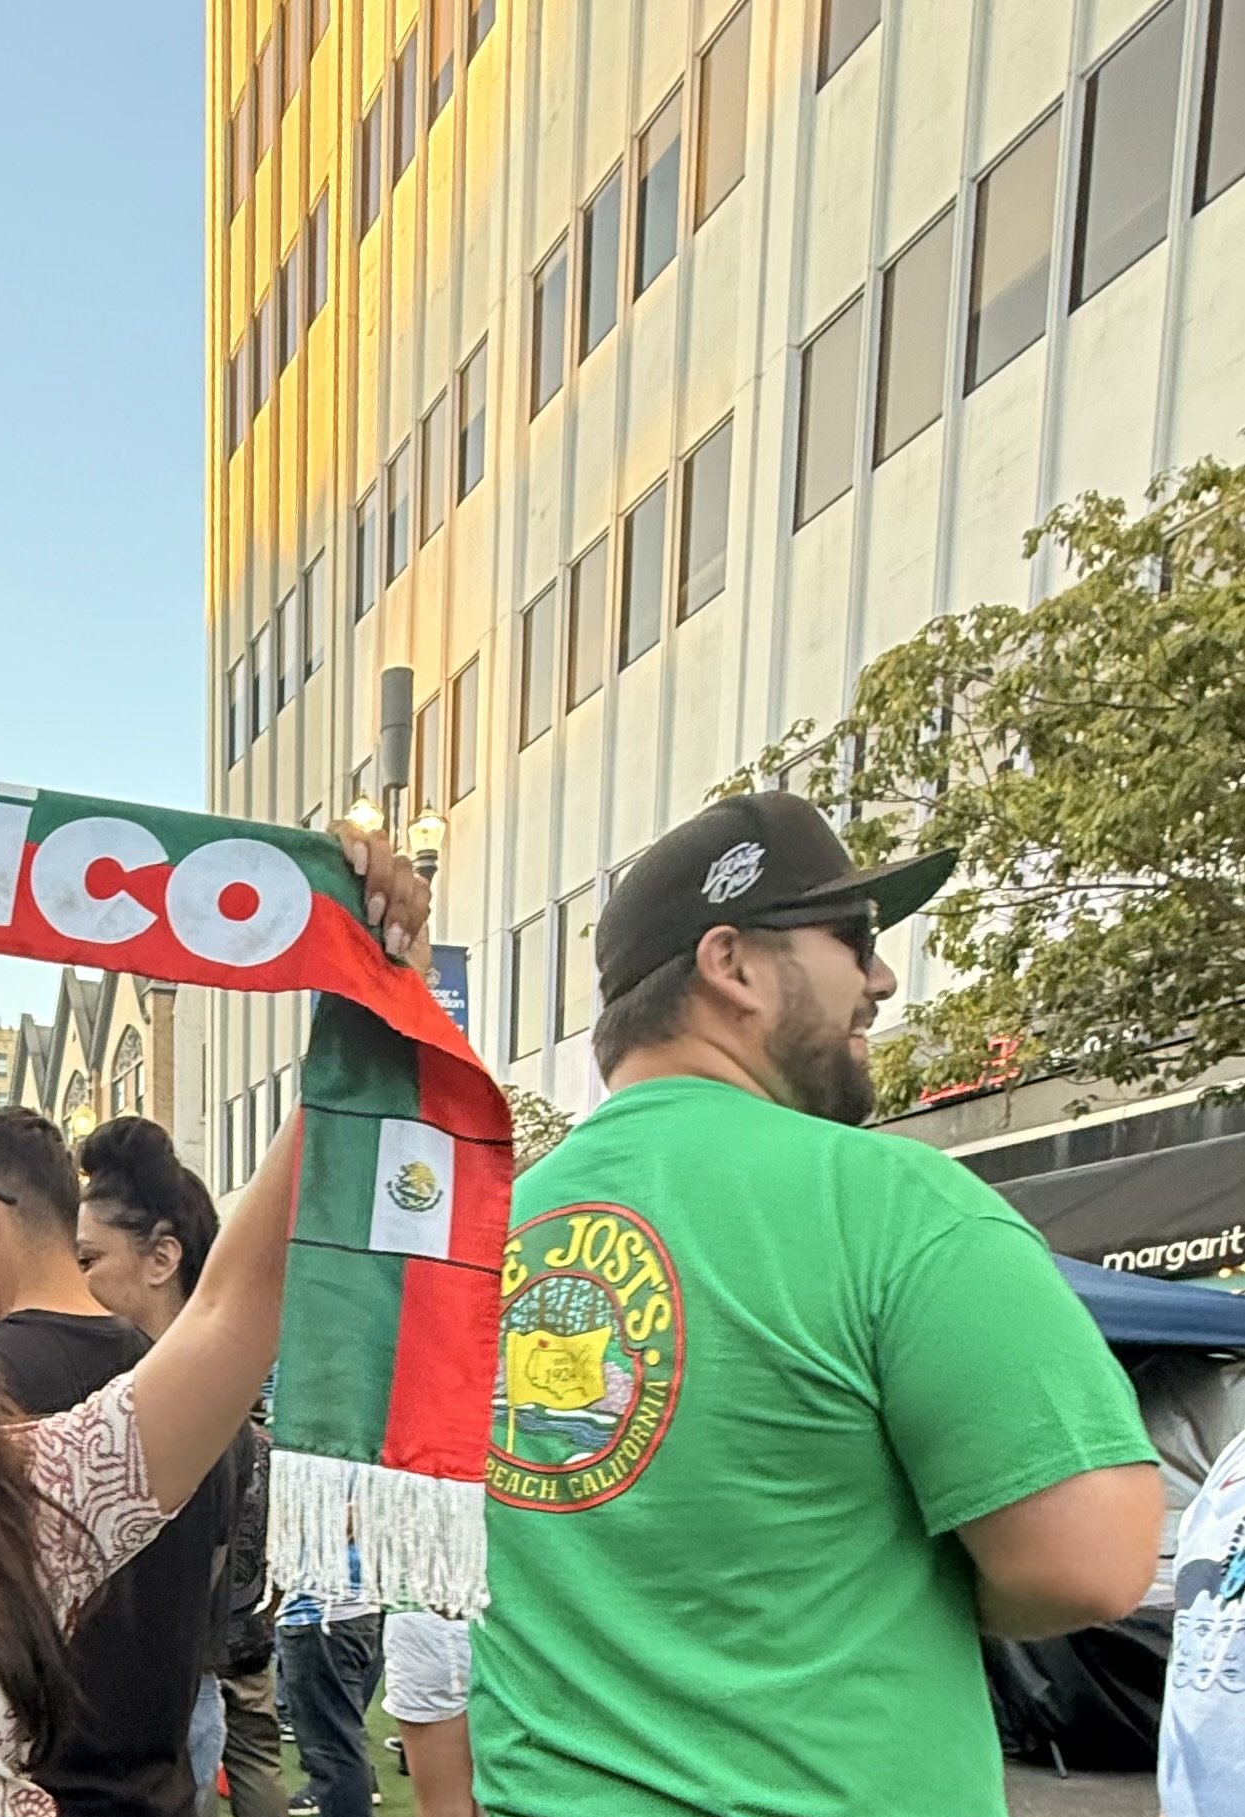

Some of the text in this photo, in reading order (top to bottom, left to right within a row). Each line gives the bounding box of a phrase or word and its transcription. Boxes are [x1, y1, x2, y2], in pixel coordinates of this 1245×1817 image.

[544, 1216, 672, 1343] JOST'S
[1102, 1225, 1245, 1271] margarit
[567, 1380, 668, 1498] CALIFORNIA
